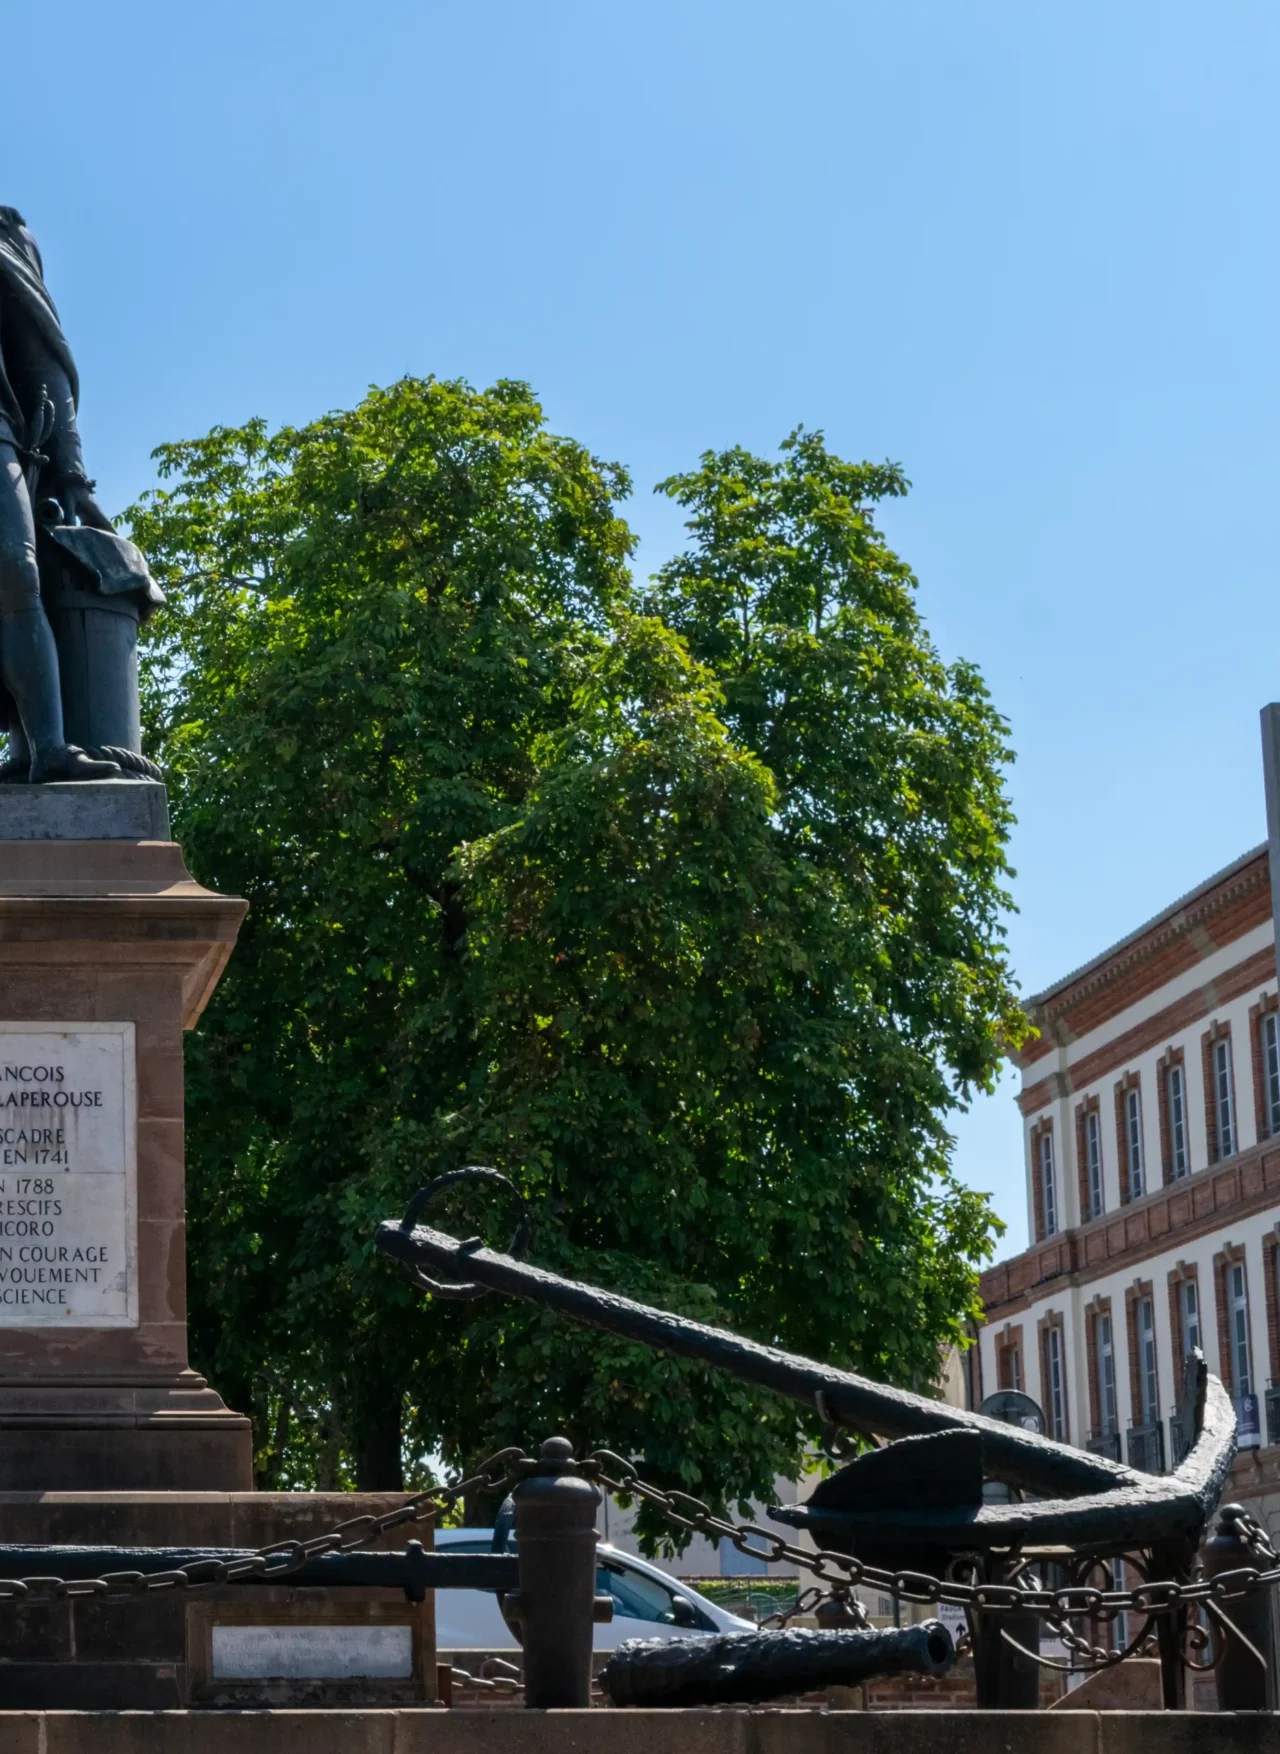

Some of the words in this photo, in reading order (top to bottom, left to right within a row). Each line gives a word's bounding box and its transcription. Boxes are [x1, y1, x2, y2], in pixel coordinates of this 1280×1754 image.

[3, 1149, 28, 1164] EN
[34, 1149, 69, 1164] 1741
[16, 1179, 55, 1194] 1788
[19, 1247, 109, 1262] COURAGE
